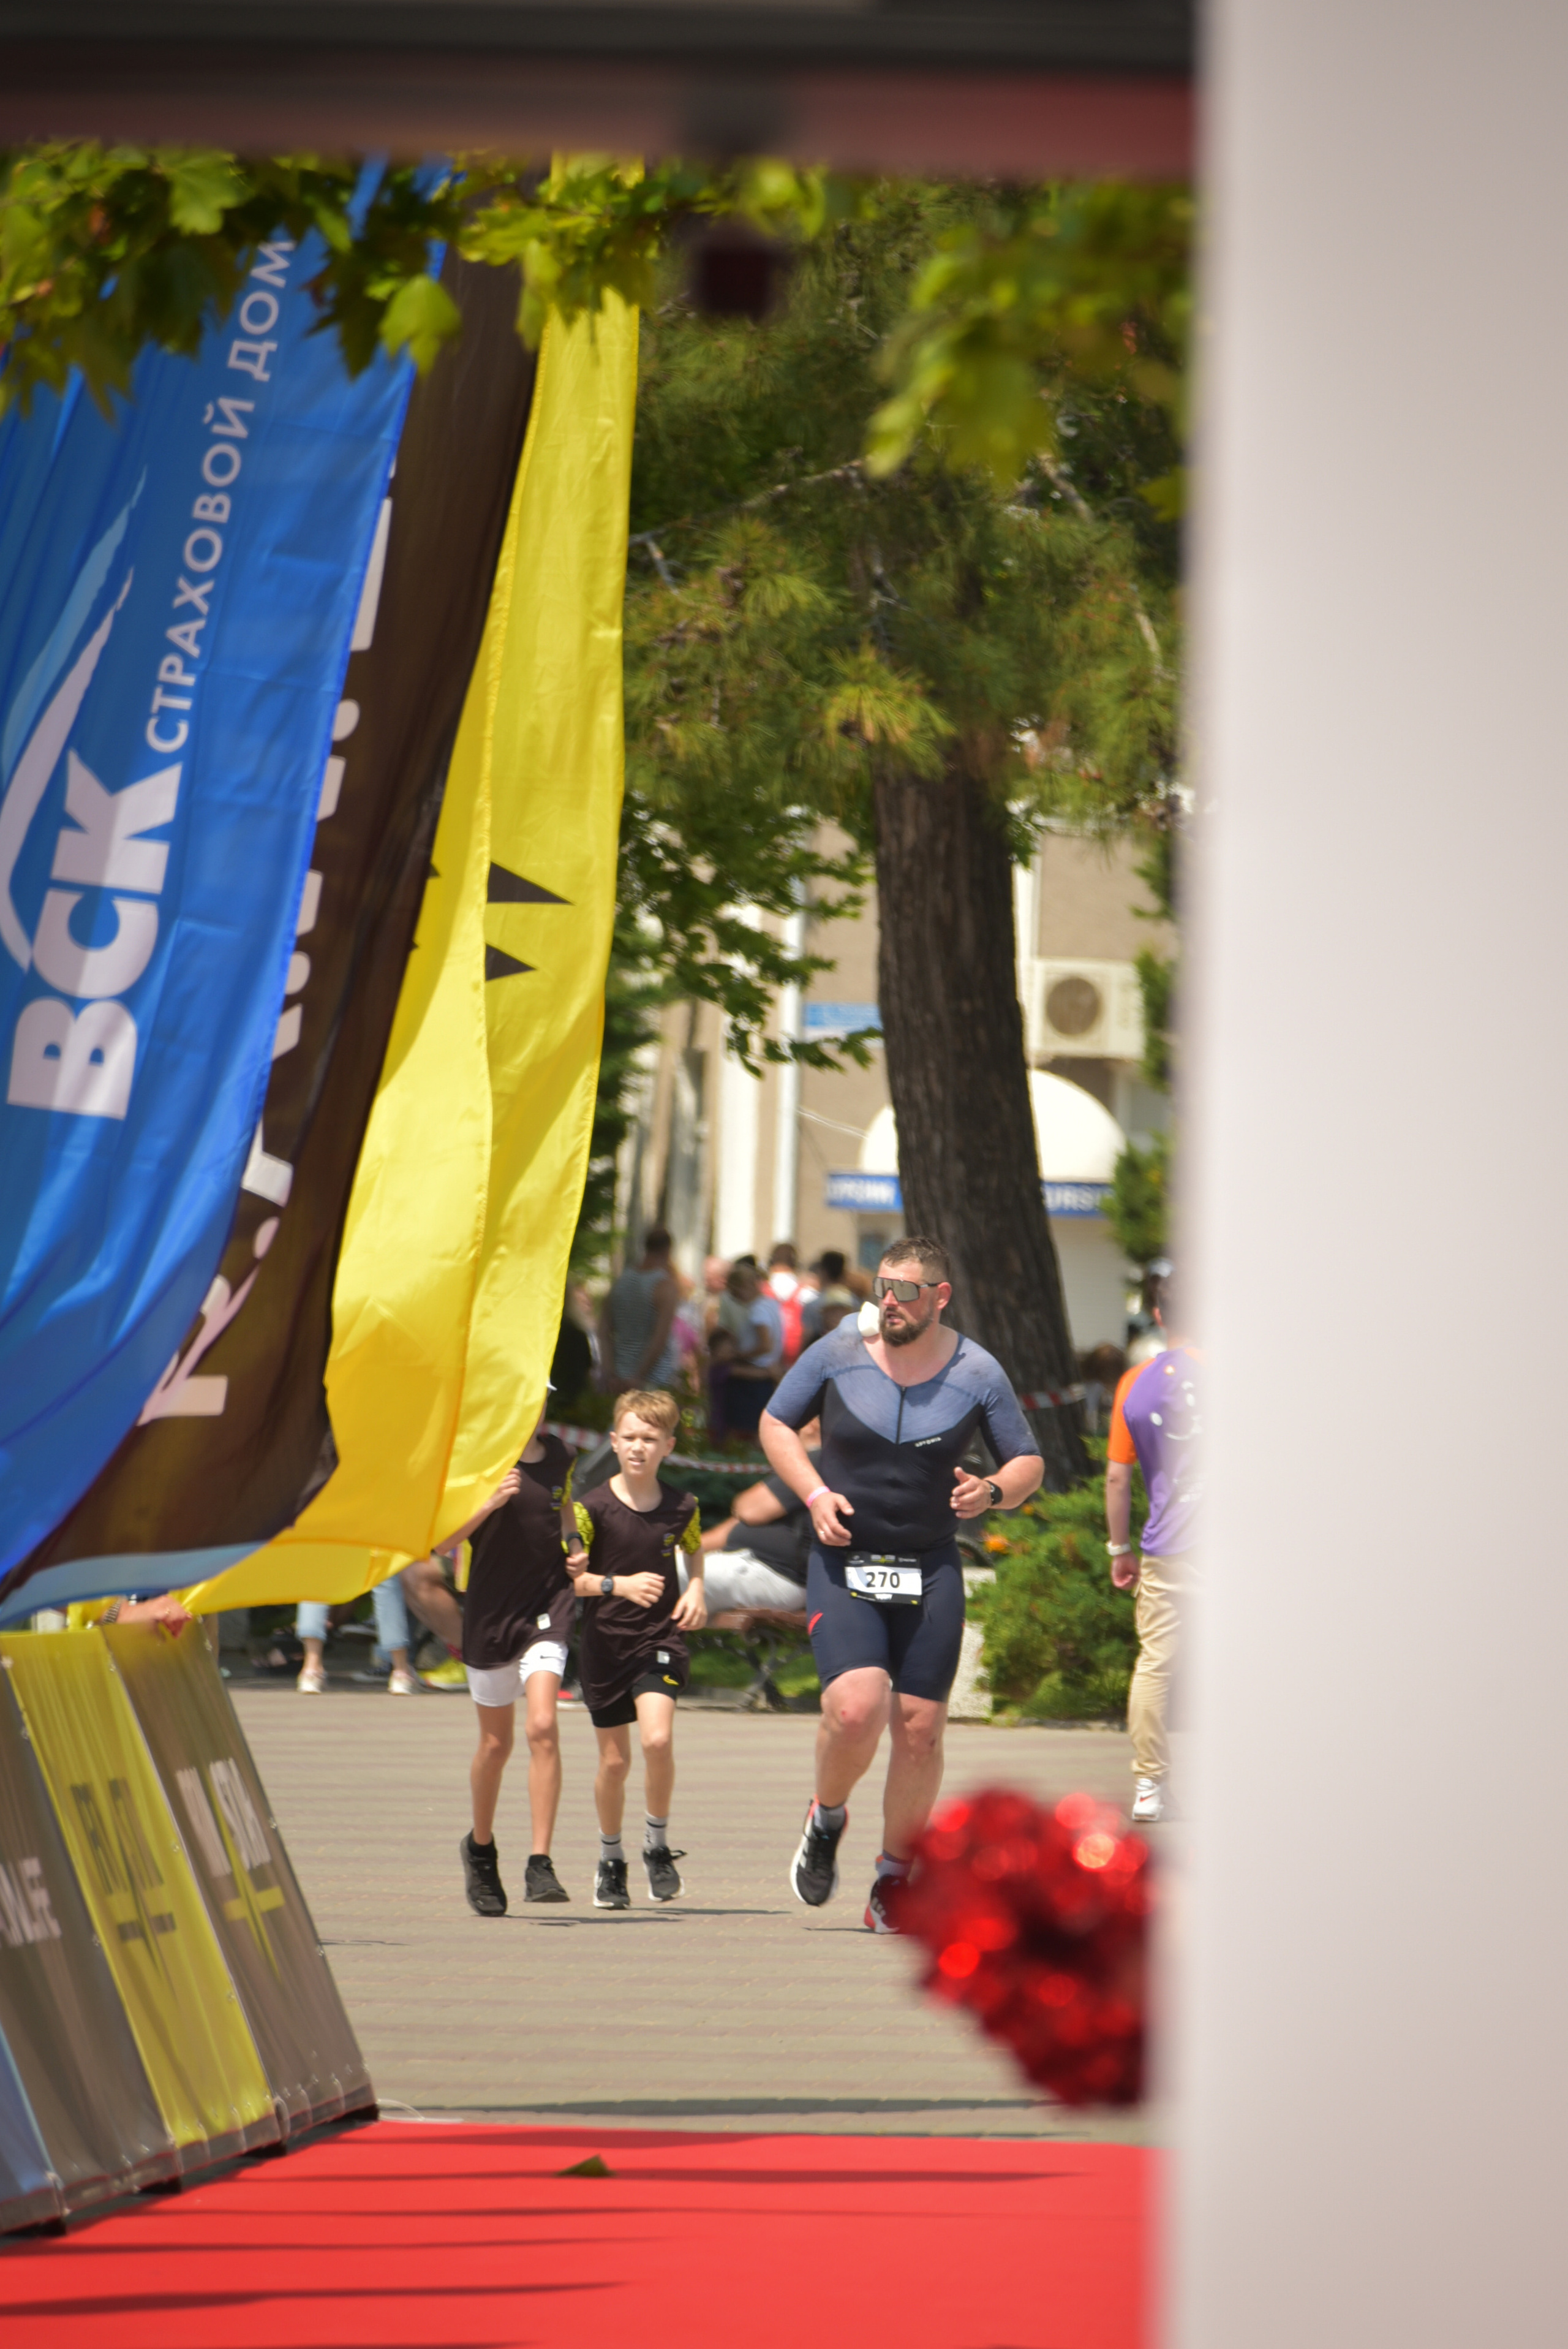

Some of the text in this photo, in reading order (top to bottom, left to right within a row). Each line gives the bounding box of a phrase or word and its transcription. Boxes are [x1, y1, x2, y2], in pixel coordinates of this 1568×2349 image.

[145, 241, 297, 754] СТРАХОВОЙ ДОМ
[7, 747, 183, 1121] ВСК
[865, 1572, 900, 1589] 270
